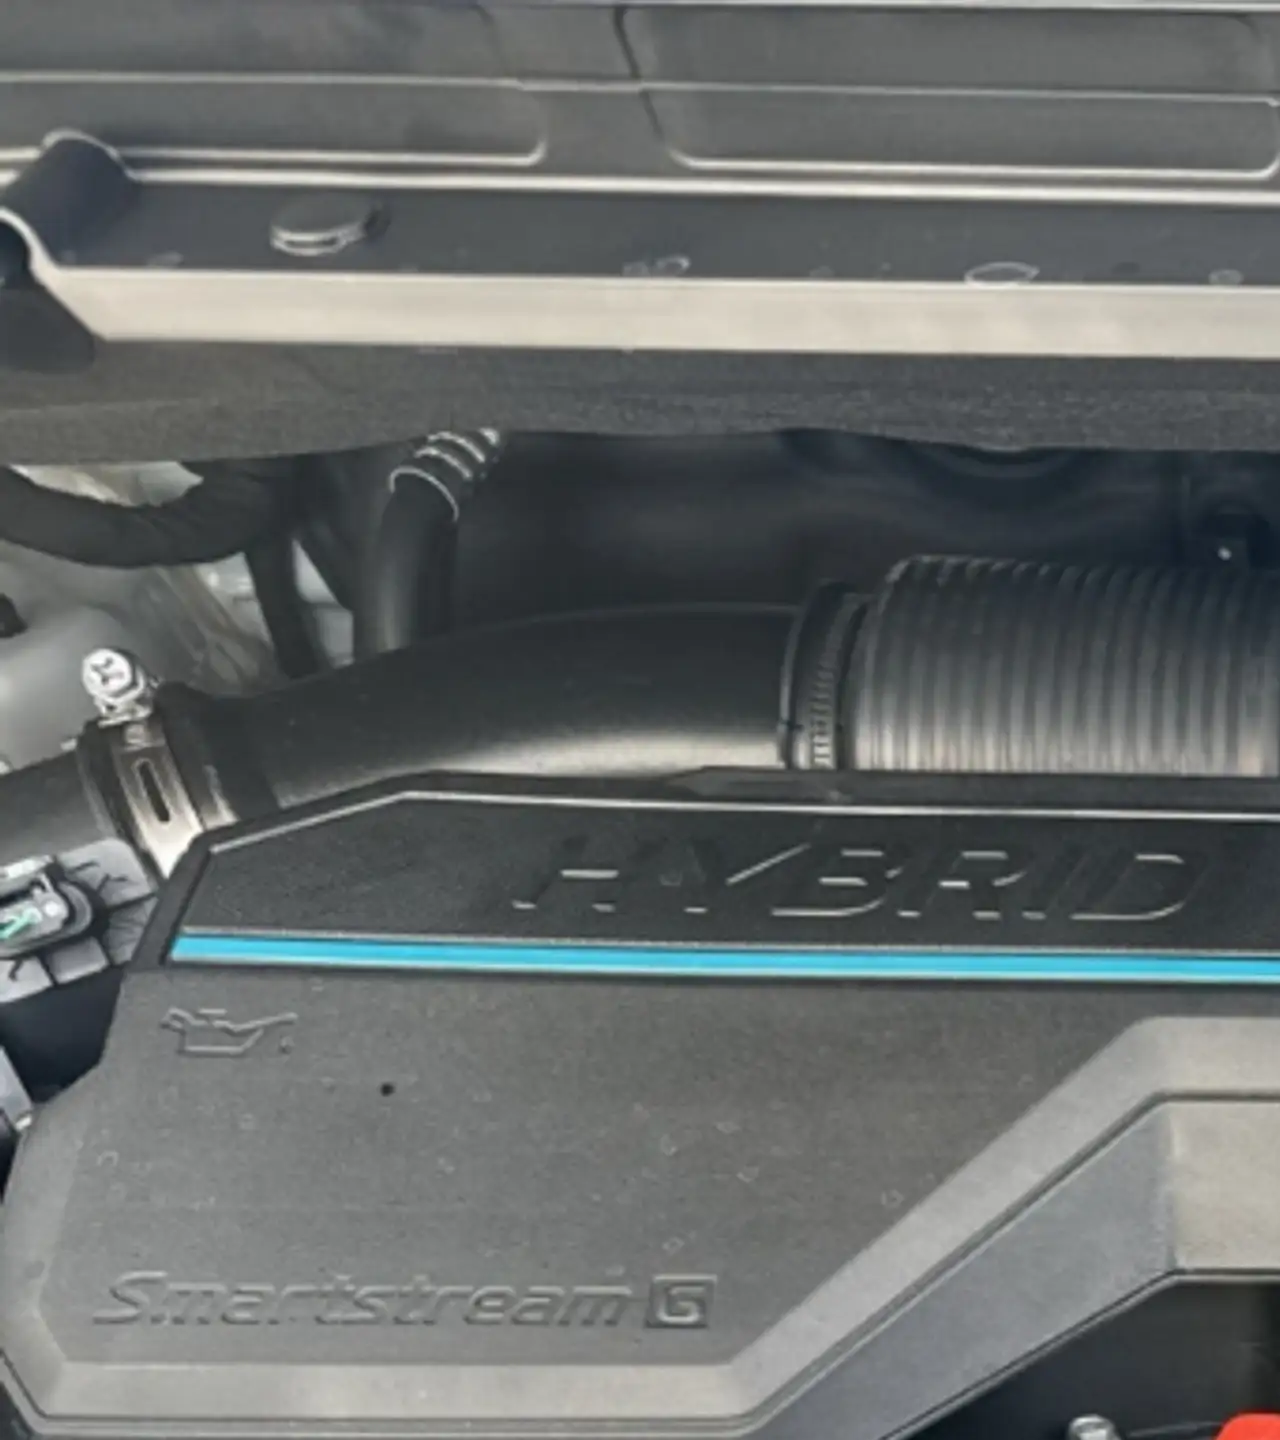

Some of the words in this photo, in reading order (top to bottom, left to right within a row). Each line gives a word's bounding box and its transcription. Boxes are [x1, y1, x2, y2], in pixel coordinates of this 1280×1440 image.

[510, 844, 1198, 922] HYBRID
[93, 1270, 634, 1328] Smartstream
[648, 1275, 714, 1328] G
